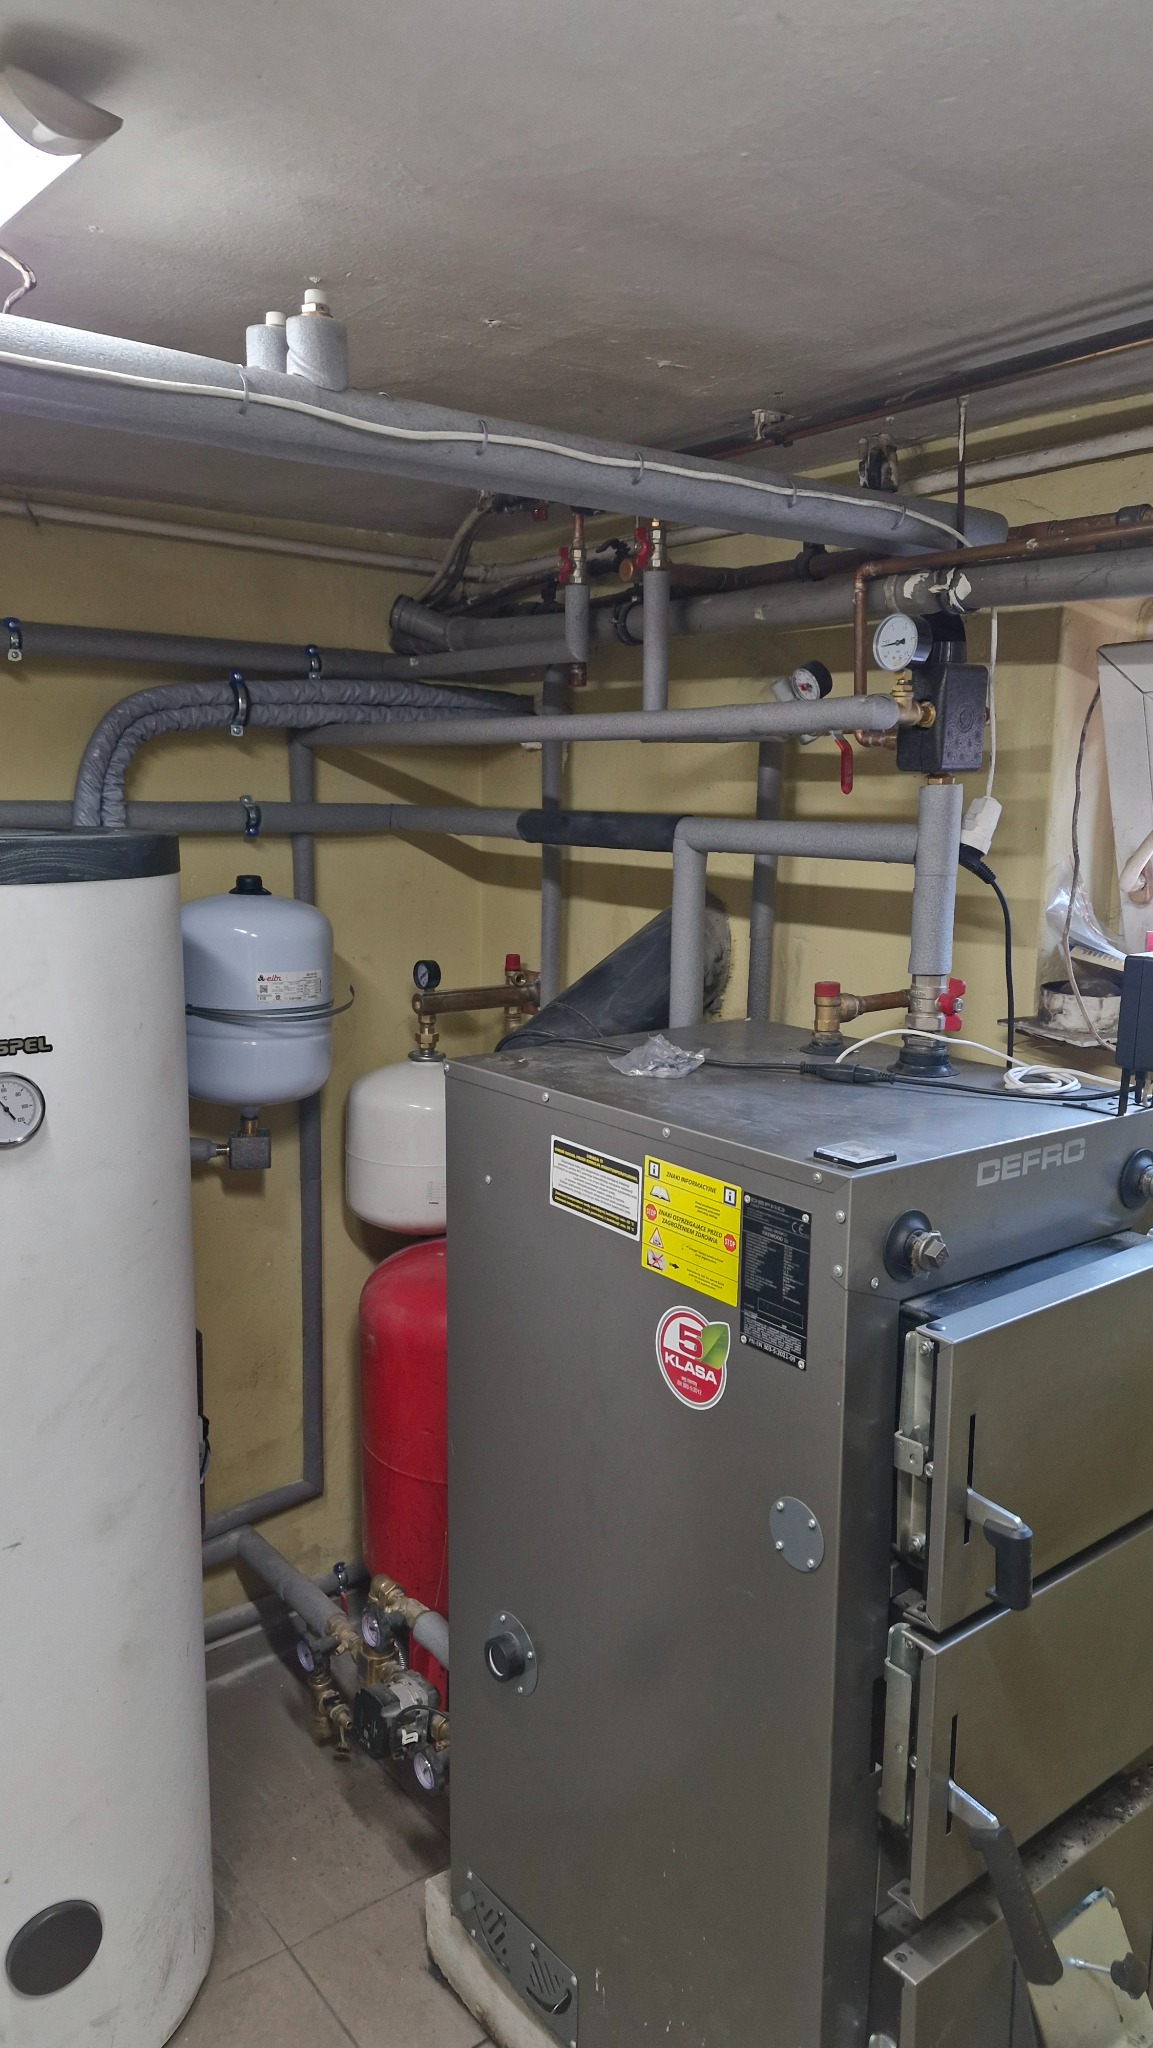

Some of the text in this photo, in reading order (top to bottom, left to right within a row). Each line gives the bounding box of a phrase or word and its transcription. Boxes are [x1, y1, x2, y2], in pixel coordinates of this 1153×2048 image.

[976, 1137, 1086, 1187] DEFRO
[666, 1171, 718, 1194] ZNAKI INFORMACYJNE
[646, 1207, 657, 1217] STOP
[658, 1208, 723, 1239] ZNAKI OSTRZEGAJĄCE PRZED
[662, 1217, 718, 1244] ZAGROŻENIEM ZDROWIA
[724, 1238, 736, 1247] STOP
[679, 1322, 704, 1360] 5
[664, 1351, 718, 1386] KLASA
